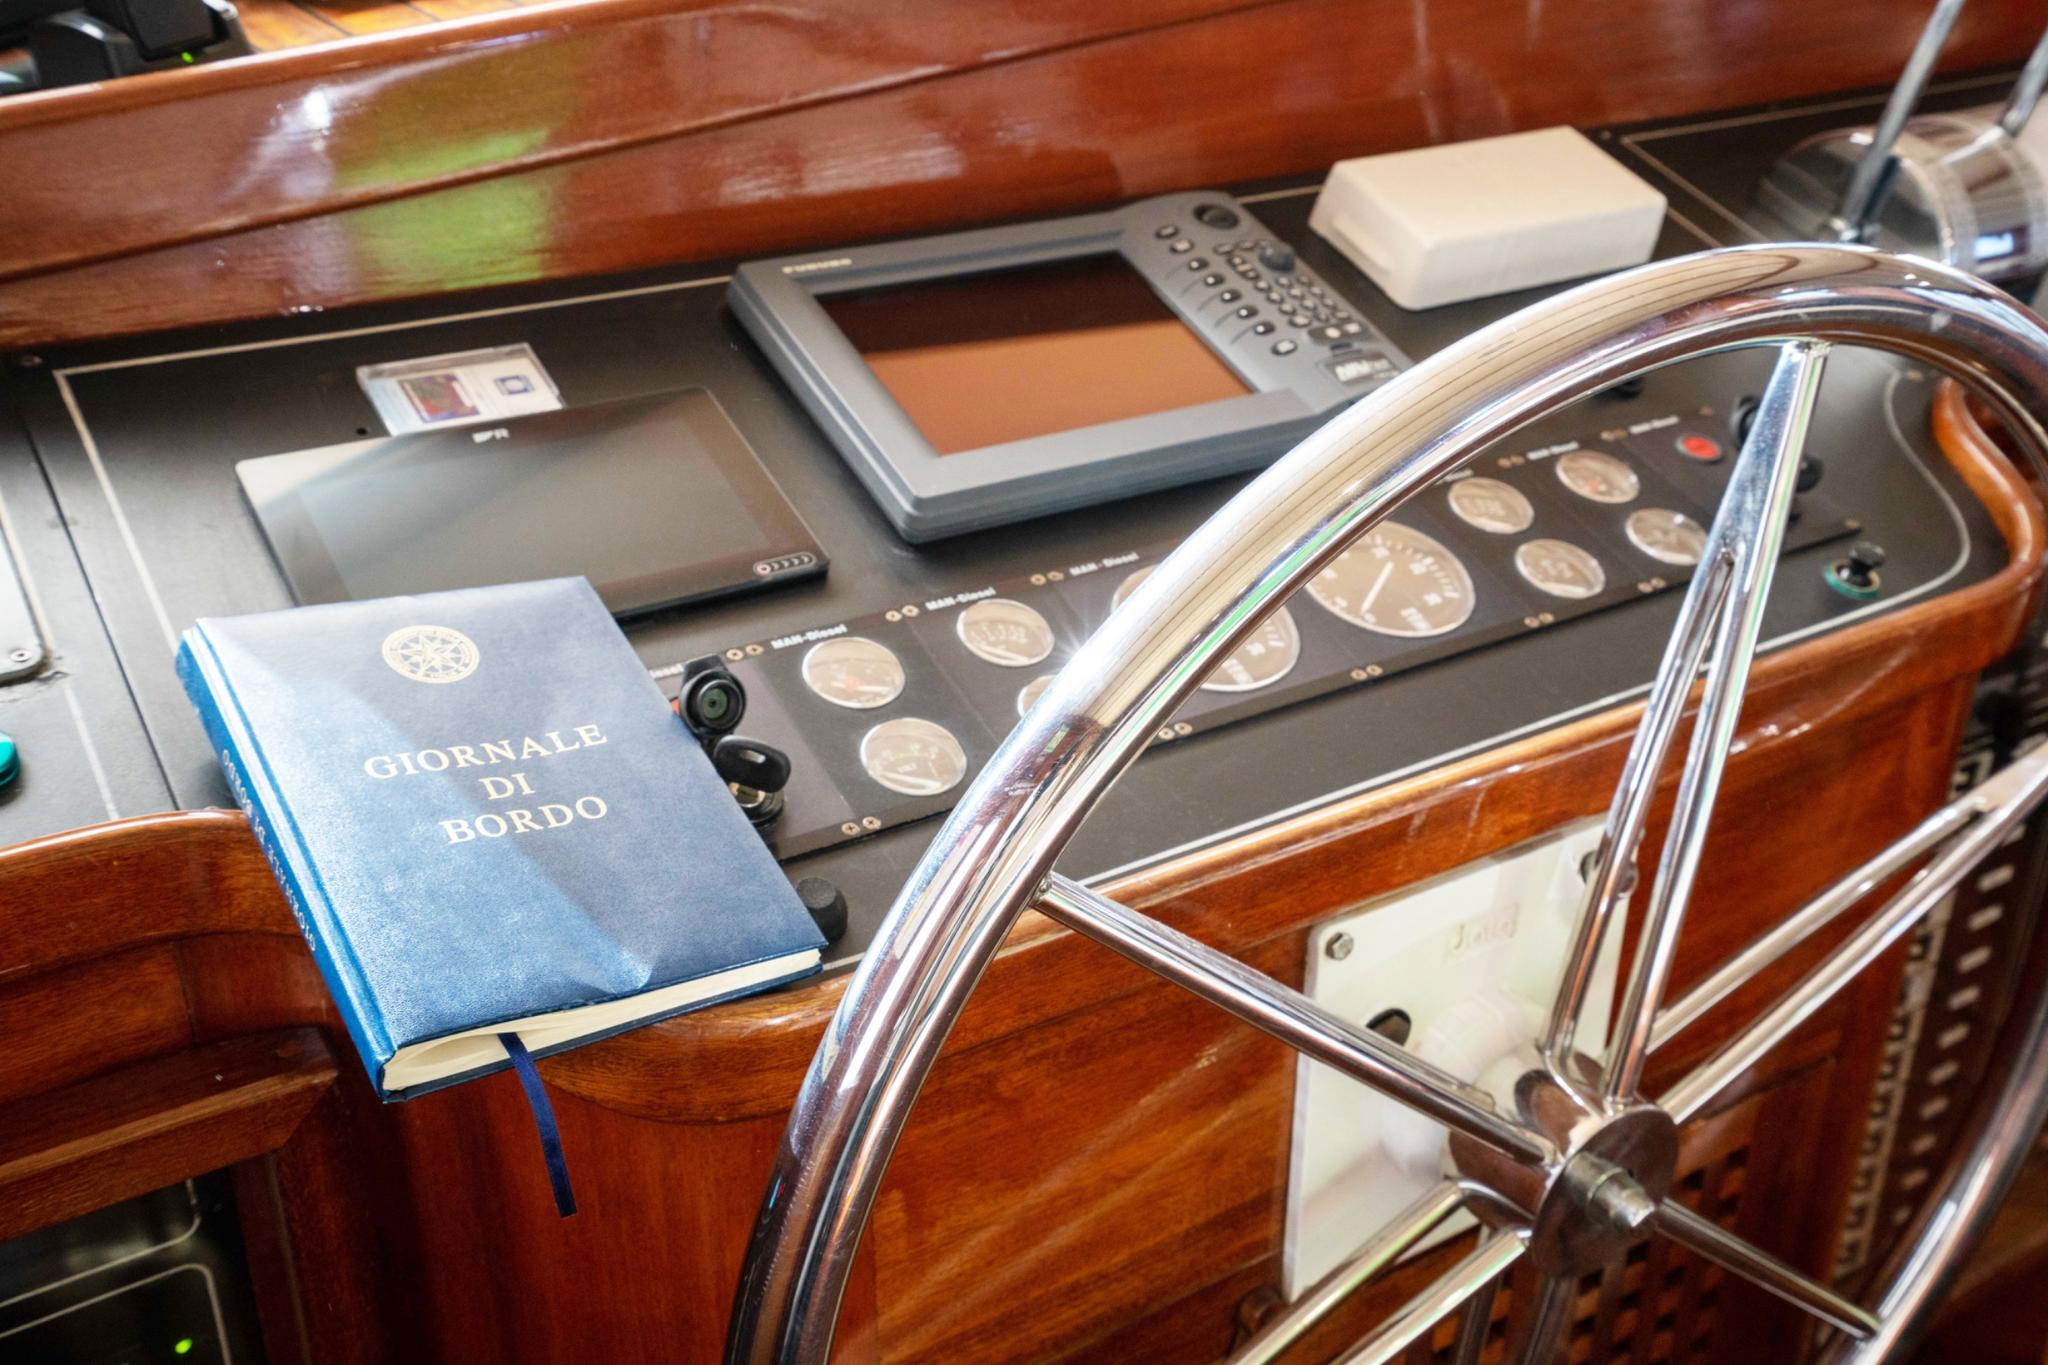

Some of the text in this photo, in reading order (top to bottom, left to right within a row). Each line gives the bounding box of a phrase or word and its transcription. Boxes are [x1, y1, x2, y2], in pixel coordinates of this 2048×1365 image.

[924, 586, 997, 611] MAN-Diesel
[770, 623, 848, 649] MAN-Diesel
[364, 724, 608, 780] GIORNALE
[222, 749, 253, 818] BORDO
[478, 773, 536, 800] DI
[438, 796, 608, 844] BORDO
